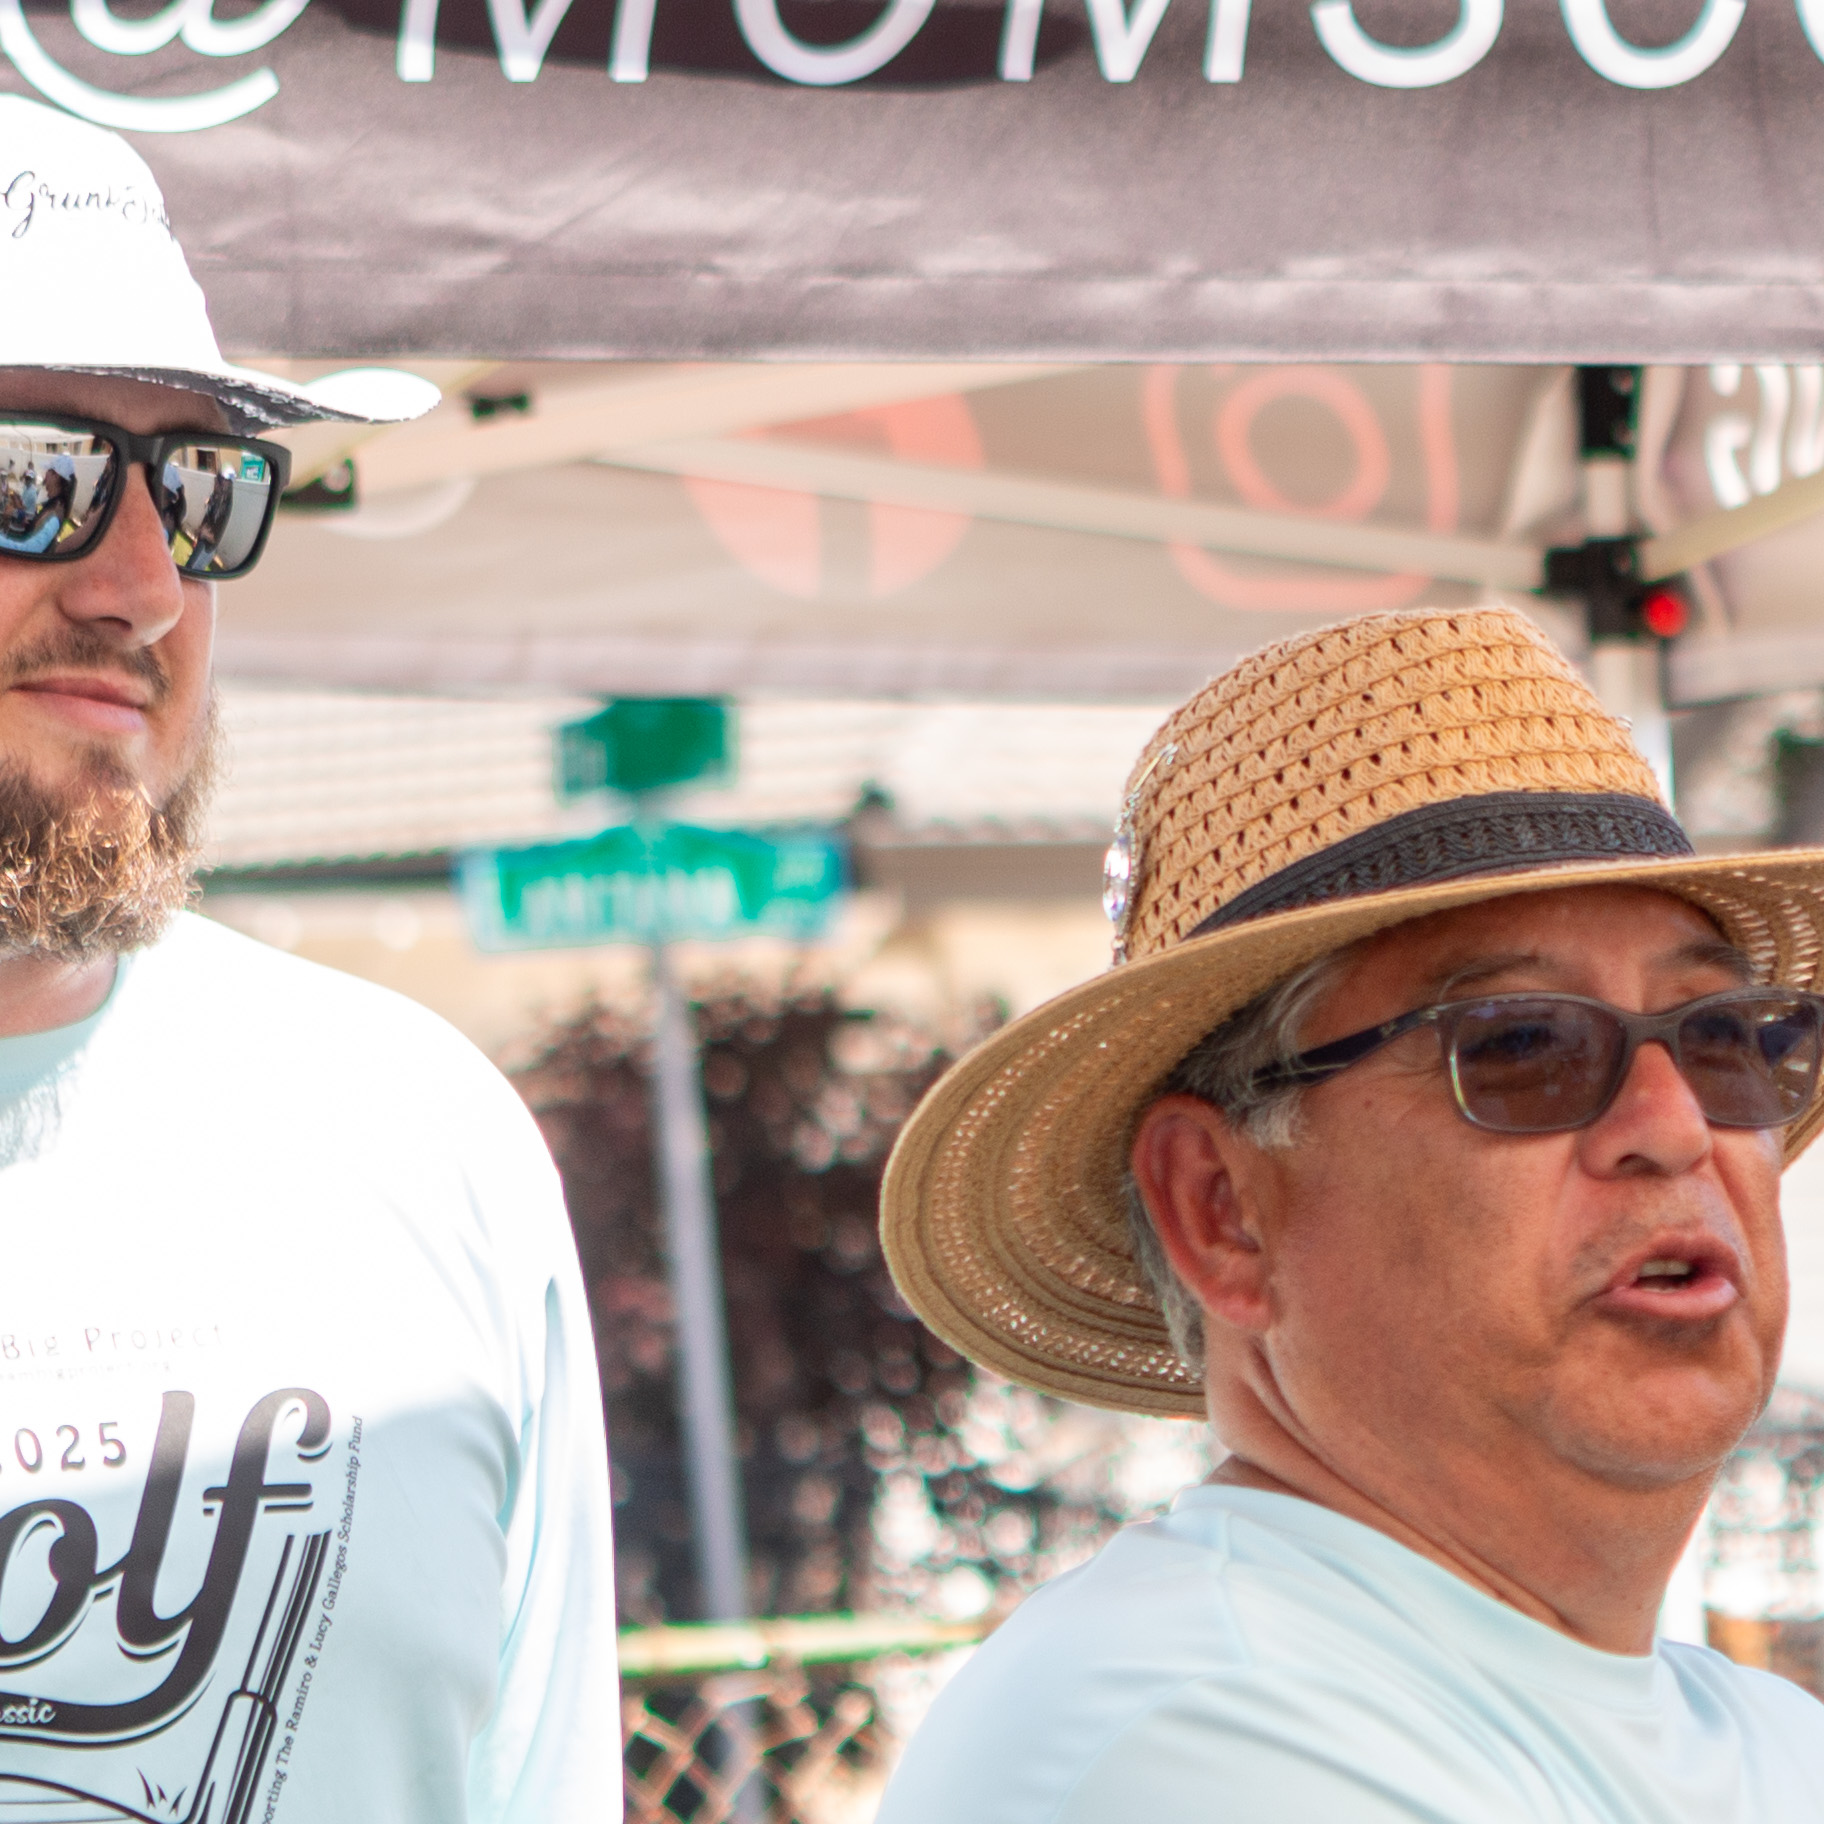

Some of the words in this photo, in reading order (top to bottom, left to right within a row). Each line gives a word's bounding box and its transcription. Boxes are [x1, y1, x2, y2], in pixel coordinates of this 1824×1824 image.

[0, 1421, 127, 1475] 025
[348, 1415, 363, 1453] Fund
[337, 1455, 362, 1543] Scholarship
[0, 1387, 332, 1705] olf
[322, 1545, 348, 1611] Gallegos
[309, 1613, 333, 1653] Lucy
[304, 1655, 318, 1669] &
[0, 1697, 56, 1725] ssic
[284, 1671, 313, 1733] Ramiro
[276, 1735, 294, 1765] The
